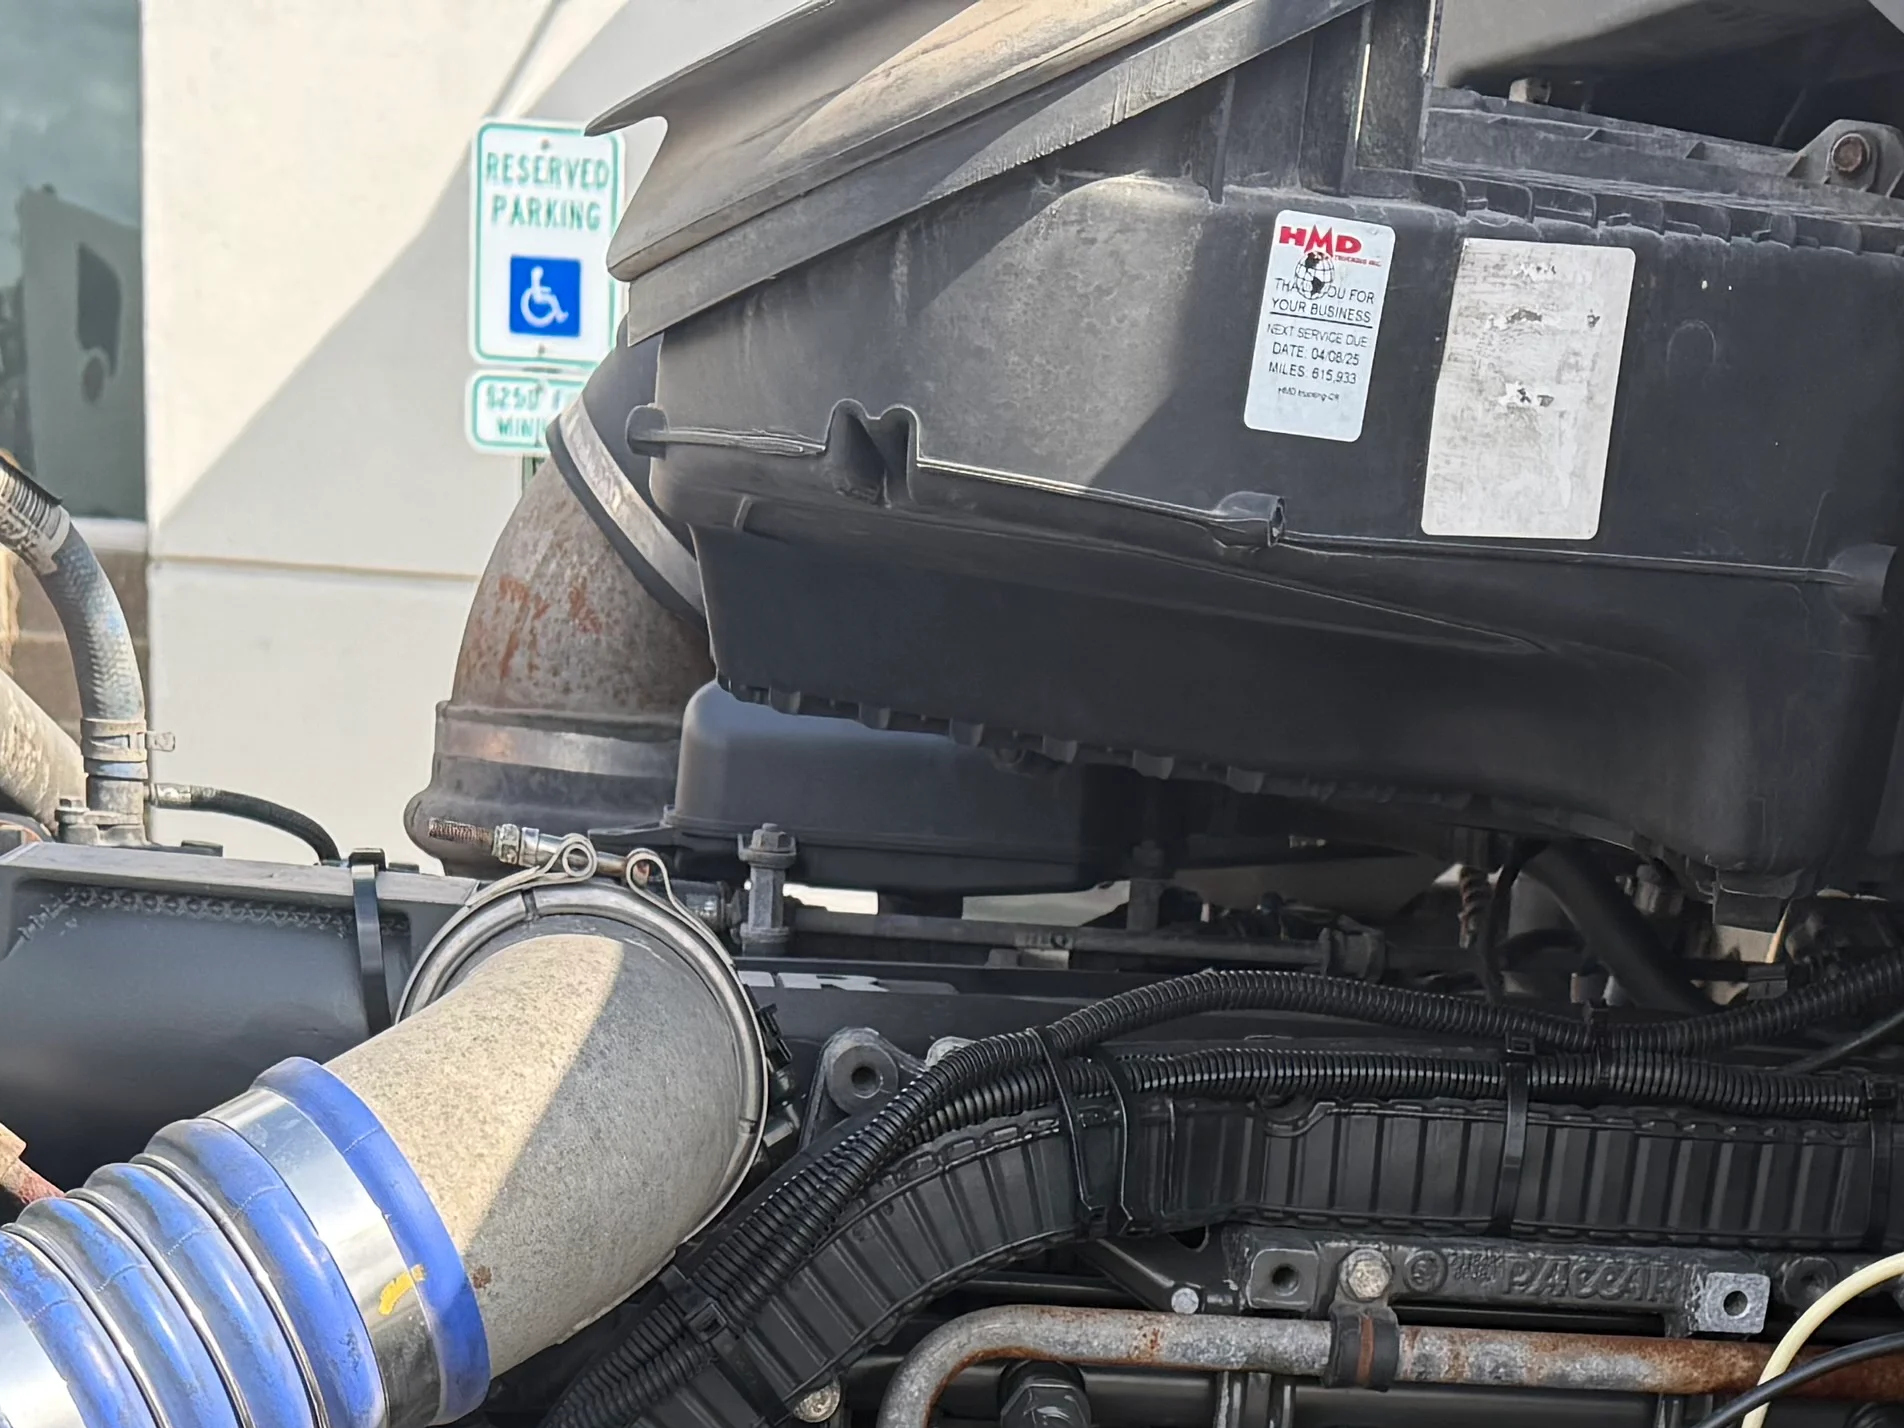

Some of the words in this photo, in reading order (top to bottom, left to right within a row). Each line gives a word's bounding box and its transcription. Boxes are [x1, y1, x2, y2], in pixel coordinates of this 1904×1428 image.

[485, 152, 610, 190] RESERVED
[491, 195, 601, 231] PARKING
[1279, 224, 1361, 257] HMD
[1350, 290, 1374, 304] FOR
[1271, 298, 1306, 313] YOUR
[1310, 303, 1371, 323] BUSINESS
[1267, 323, 1294, 336] NEXT
[1298, 327, 1342, 344] SERVICE
[1272, 342, 1306, 359] DATE:
[1269, 362, 1306, 378] MILES:
[1312, 368, 1356, 384] 615,933
